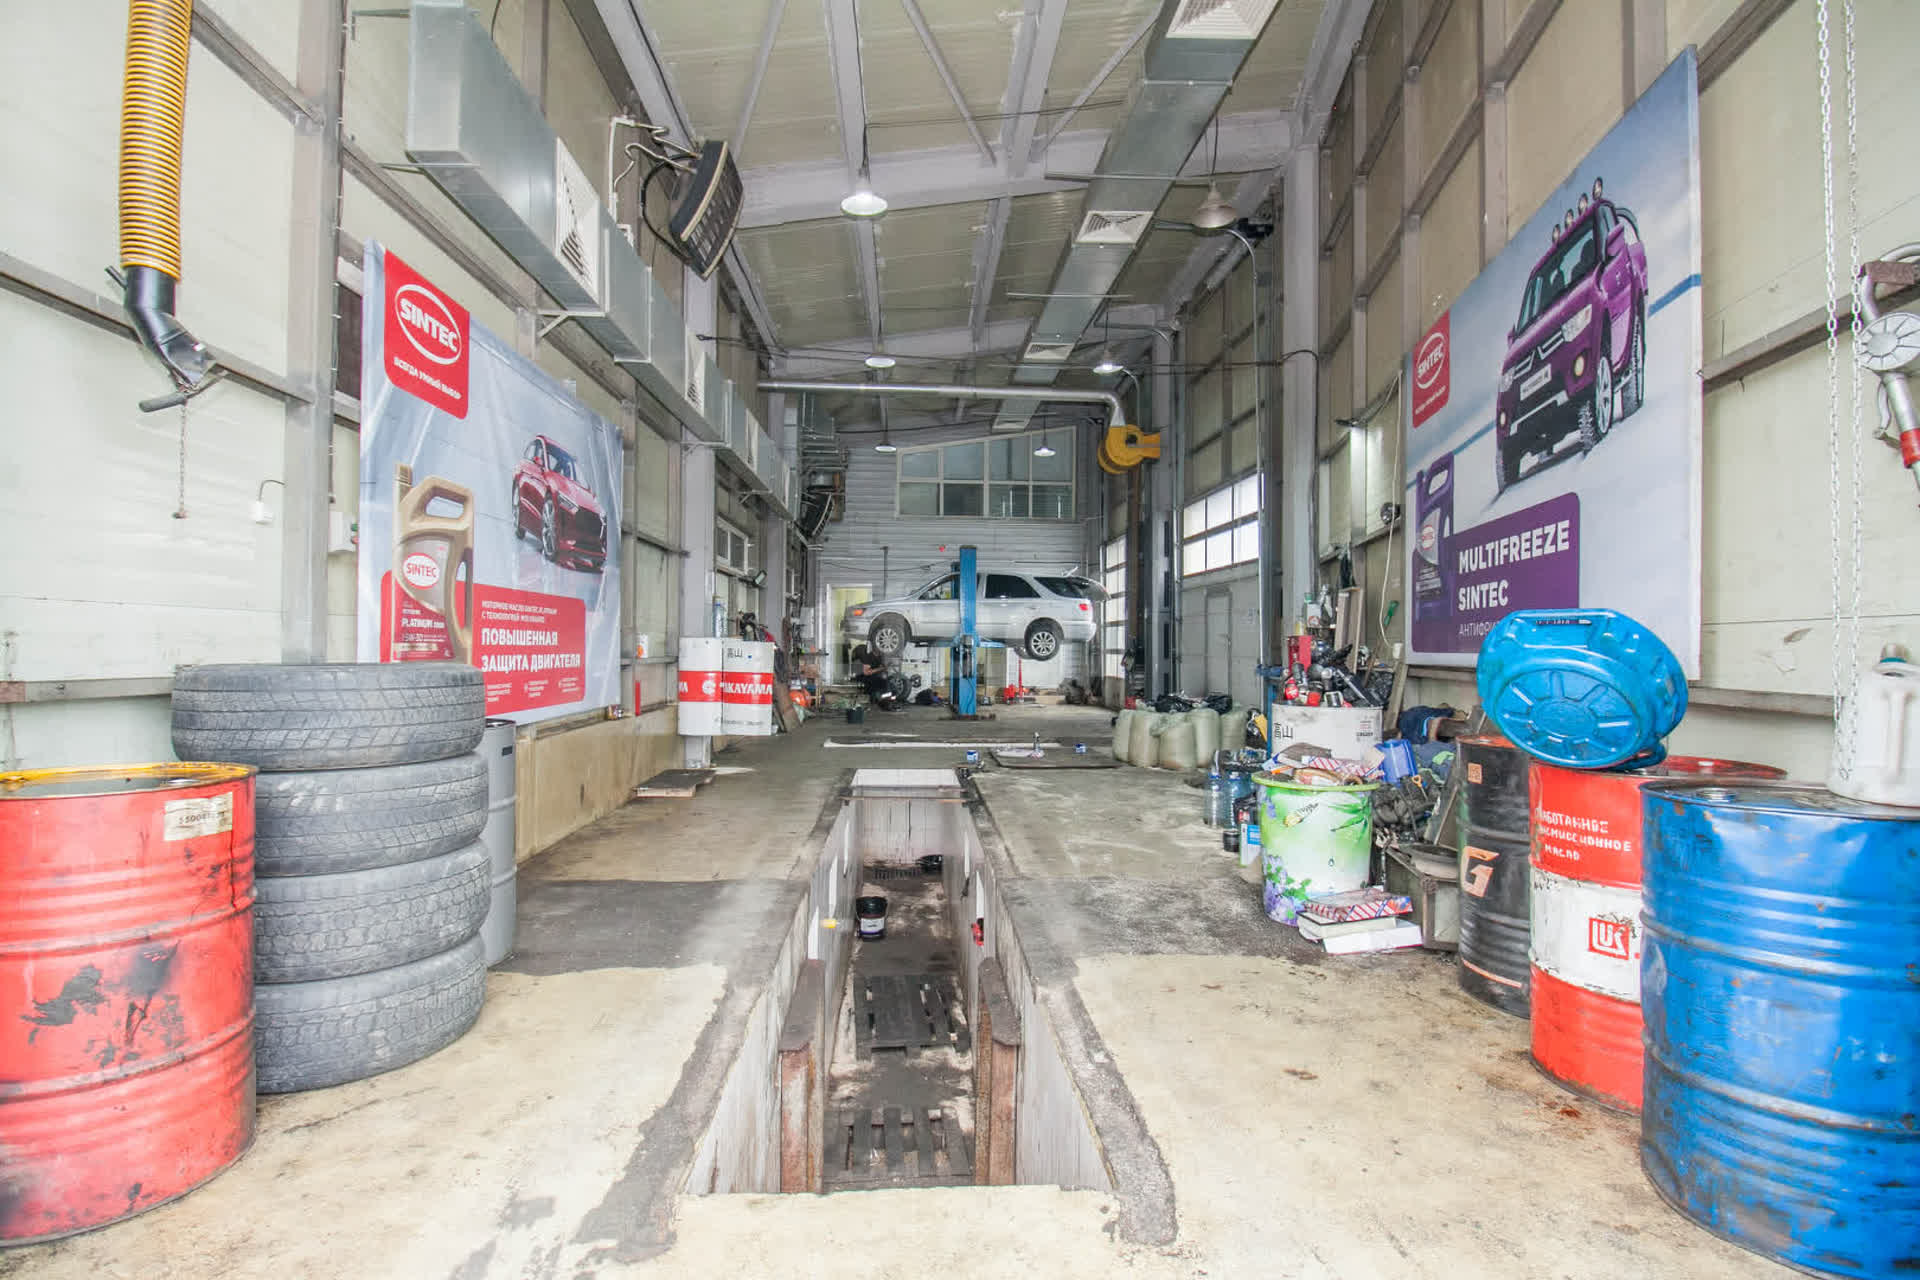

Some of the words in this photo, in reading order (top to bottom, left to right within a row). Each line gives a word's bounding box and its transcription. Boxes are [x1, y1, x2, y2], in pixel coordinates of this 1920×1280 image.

[400, 298, 457, 353] SINTEC
[1417, 341, 1444, 379] SINTEC
[1459, 519, 1570, 574] MULTIFREEZE
[406, 562, 437, 578] SINTEC
[1458, 579, 1509, 611] SINTEC
[481, 627, 558, 646] ПОВЫШЕННАЯ
[481, 654, 529, 674] ЗАЩИТА
[530, 653, 581, 673] ДВИГАТЕЛЯ
